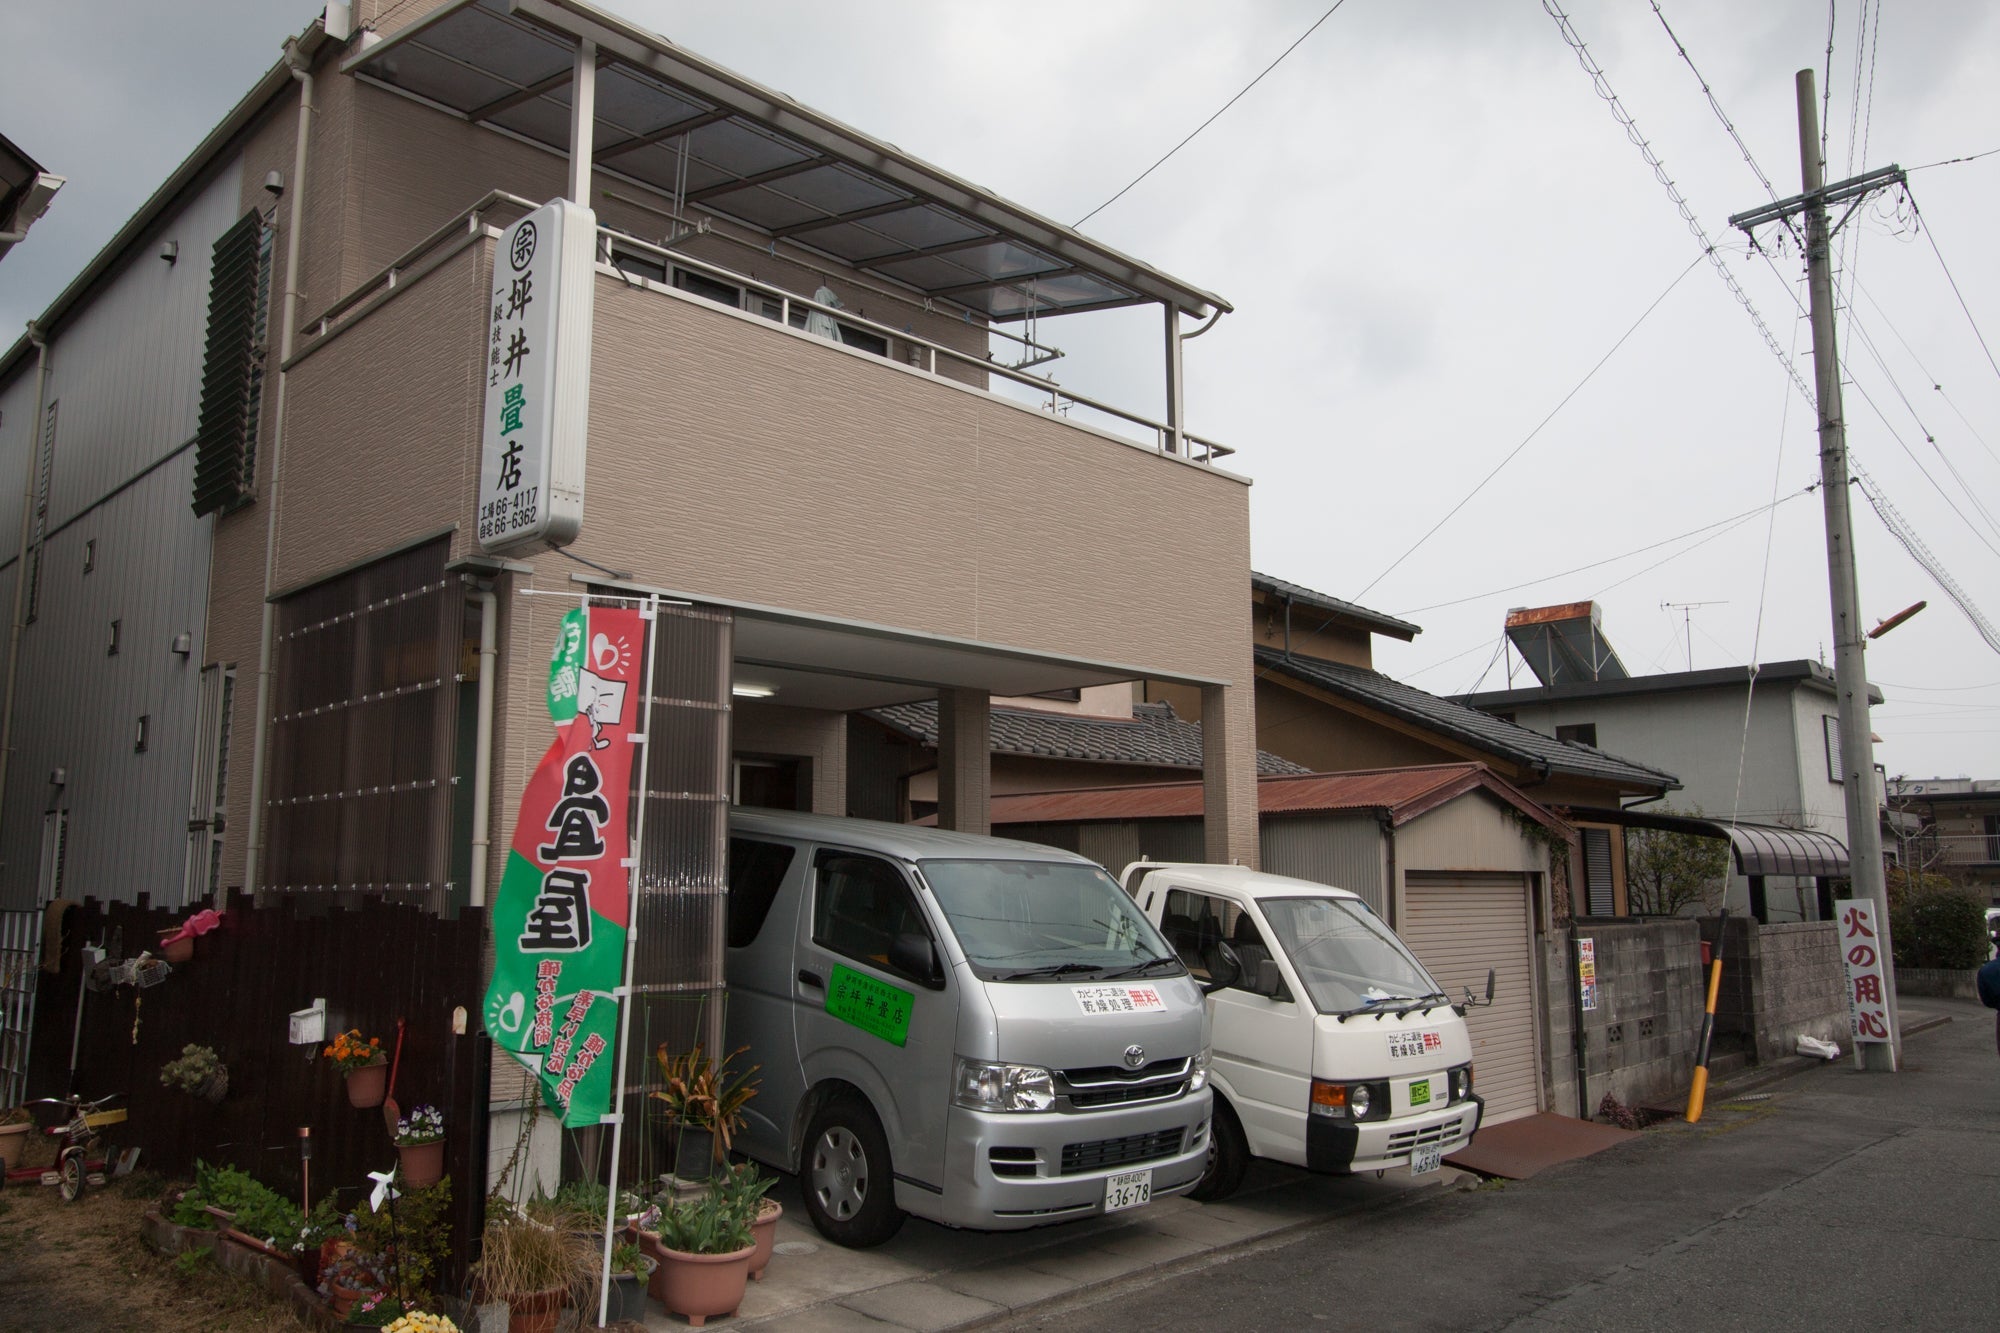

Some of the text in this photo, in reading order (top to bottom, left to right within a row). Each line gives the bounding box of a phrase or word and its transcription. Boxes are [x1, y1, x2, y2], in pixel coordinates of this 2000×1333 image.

[490, 288, 504, 388] 一級技能士
[496, 271, 533, 491] 坪井畳店
[496, 486, 538, 516] 66-4117
[480, 506, 537, 539] 自宅 66-6362
[1844, 908, 1888, 1038] 火の用心
[1082, 998, 1134, 1013] 乾燥処理
[1128, 989, 1161, 1008] 無料
[1390, 1042, 1424, 1058] 乾燥処理
[1423, 1032, 1442, 1050] 無料
[1114, 1184, 1149, 1207] 36-78
